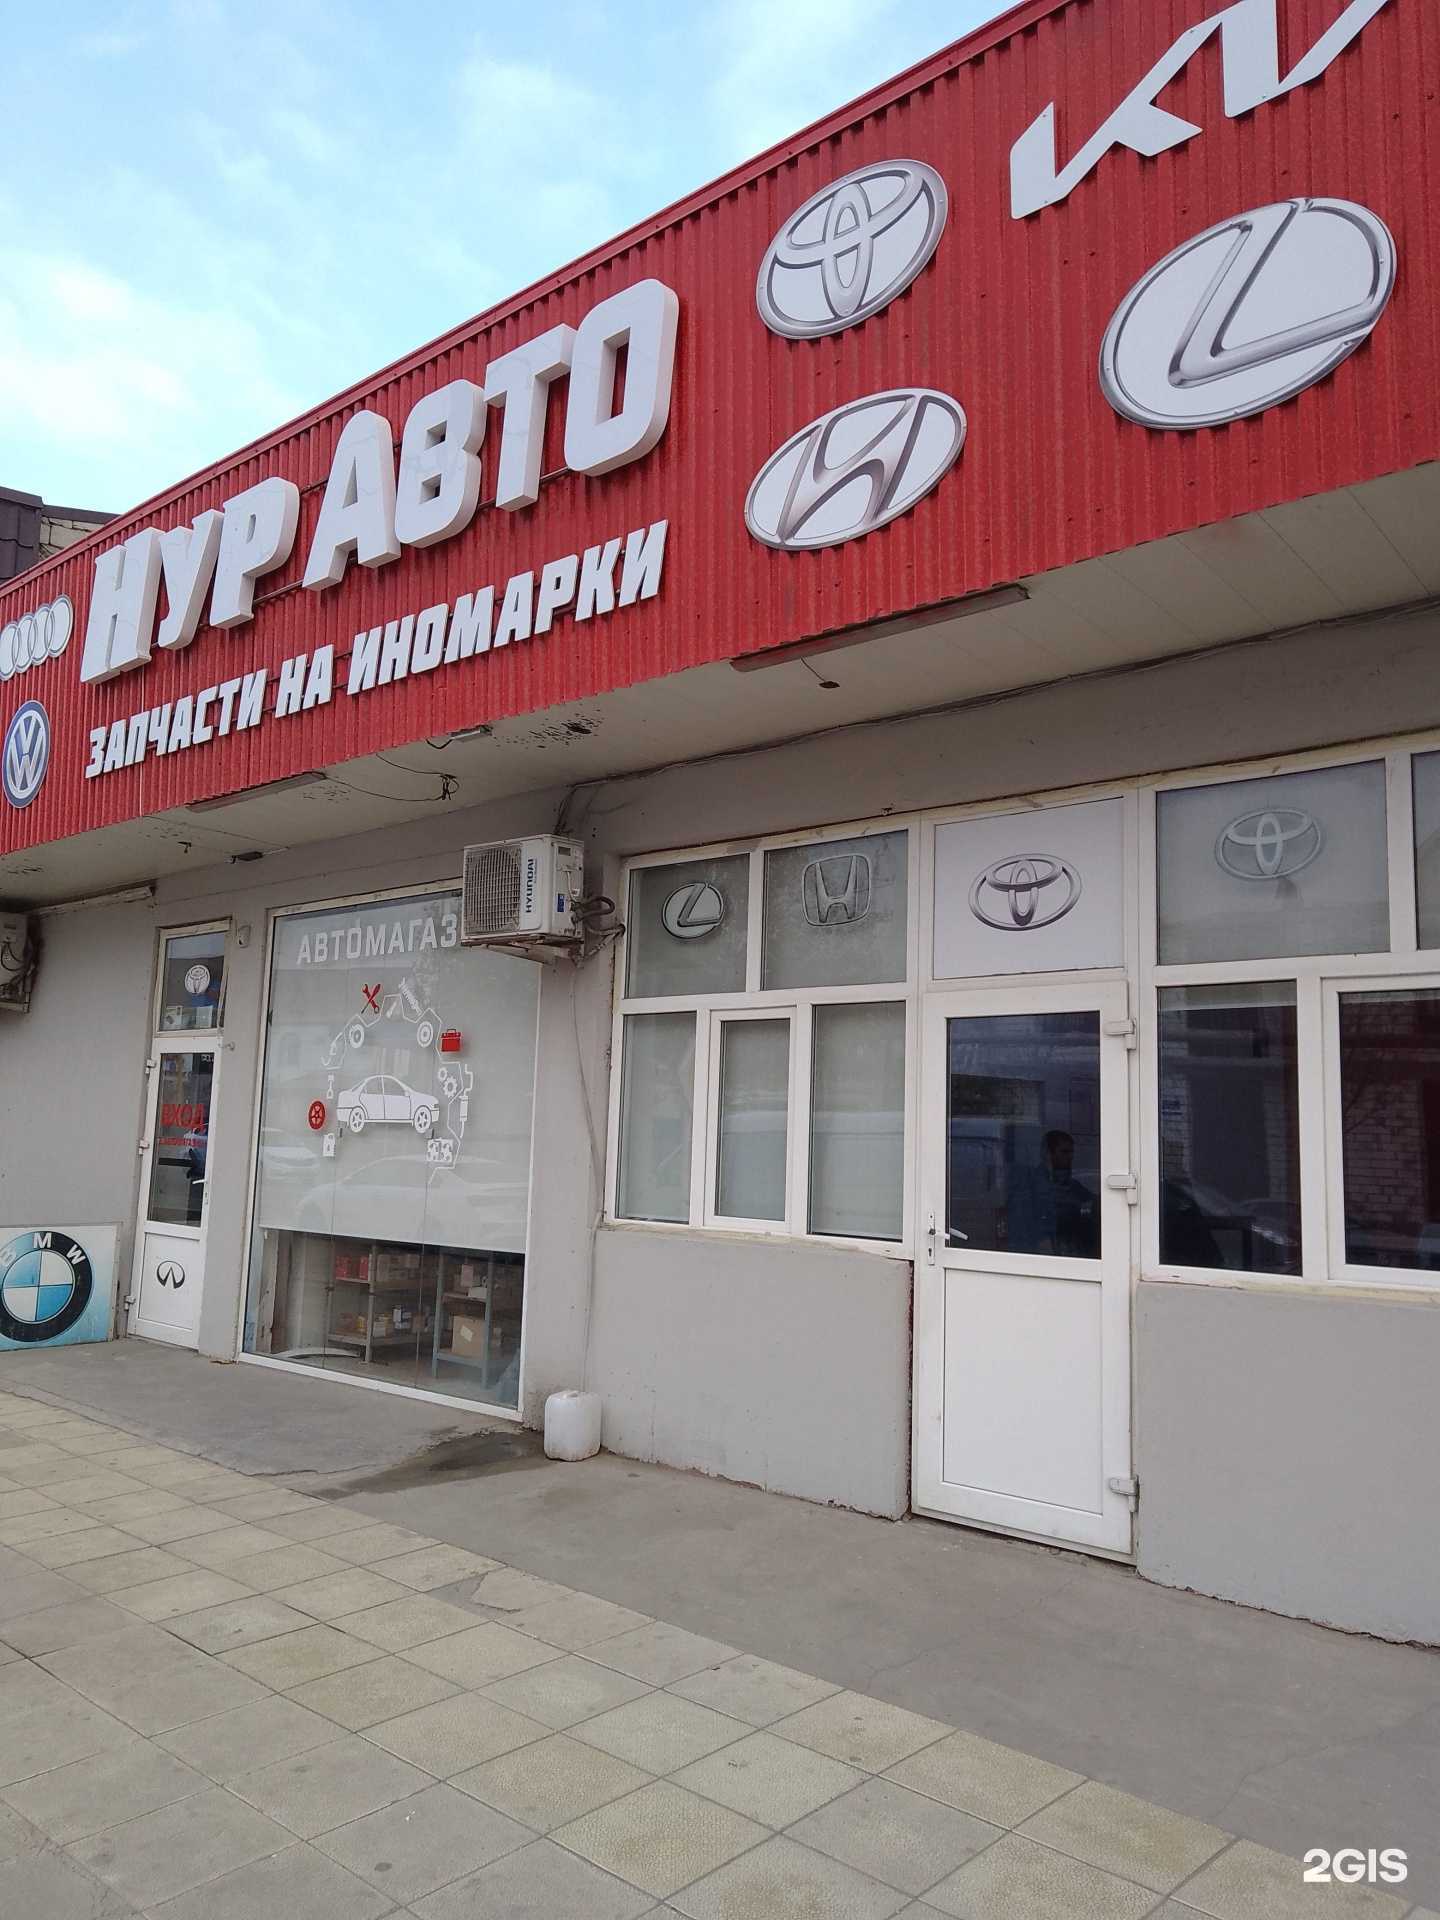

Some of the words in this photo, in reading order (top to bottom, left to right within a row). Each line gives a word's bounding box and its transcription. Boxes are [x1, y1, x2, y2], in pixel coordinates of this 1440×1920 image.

[80, 476, 300, 685] НУР
[302, 278, 680, 592] АВТО
[85, 668, 268, 779] ЗАПЧАСТИ
[275, 644, 334, 719] НА
[347, 519, 669, 696] ИНОМАРКИ
[525, 858, 534, 913] HYUNDAI
[160, 1103, 206, 1134] ВХОД
